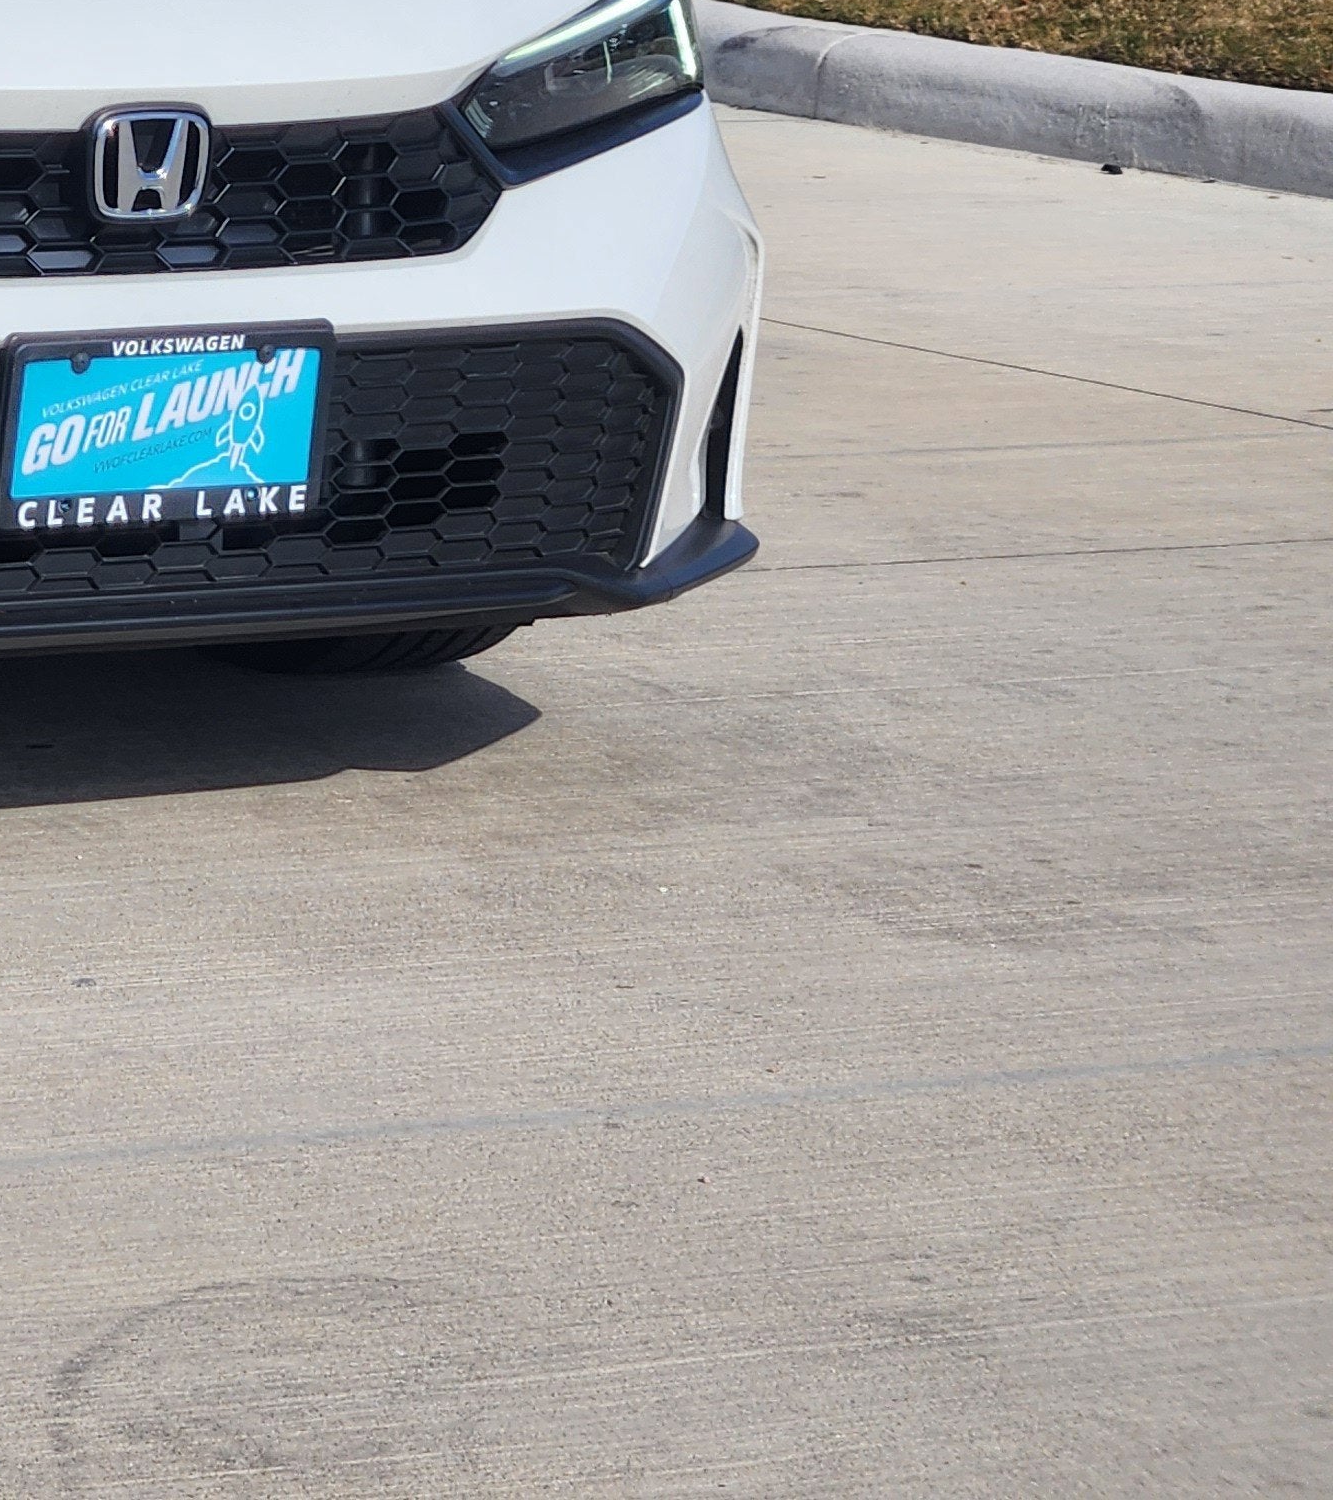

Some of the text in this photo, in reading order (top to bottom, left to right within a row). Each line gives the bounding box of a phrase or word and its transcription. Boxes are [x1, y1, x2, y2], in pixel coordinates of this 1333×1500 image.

[112, 334, 246, 357] VOLKSWAGEN
[21, 347, 306, 476] GO FOR LAUNCH
[41, 359, 204, 418] VOLKSWAGEN CLEAR LAKE
[94, 427, 213, 474] VWOFCLEARLAKE.COM
[17, 484, 308, 529] CLEAR LAKE
